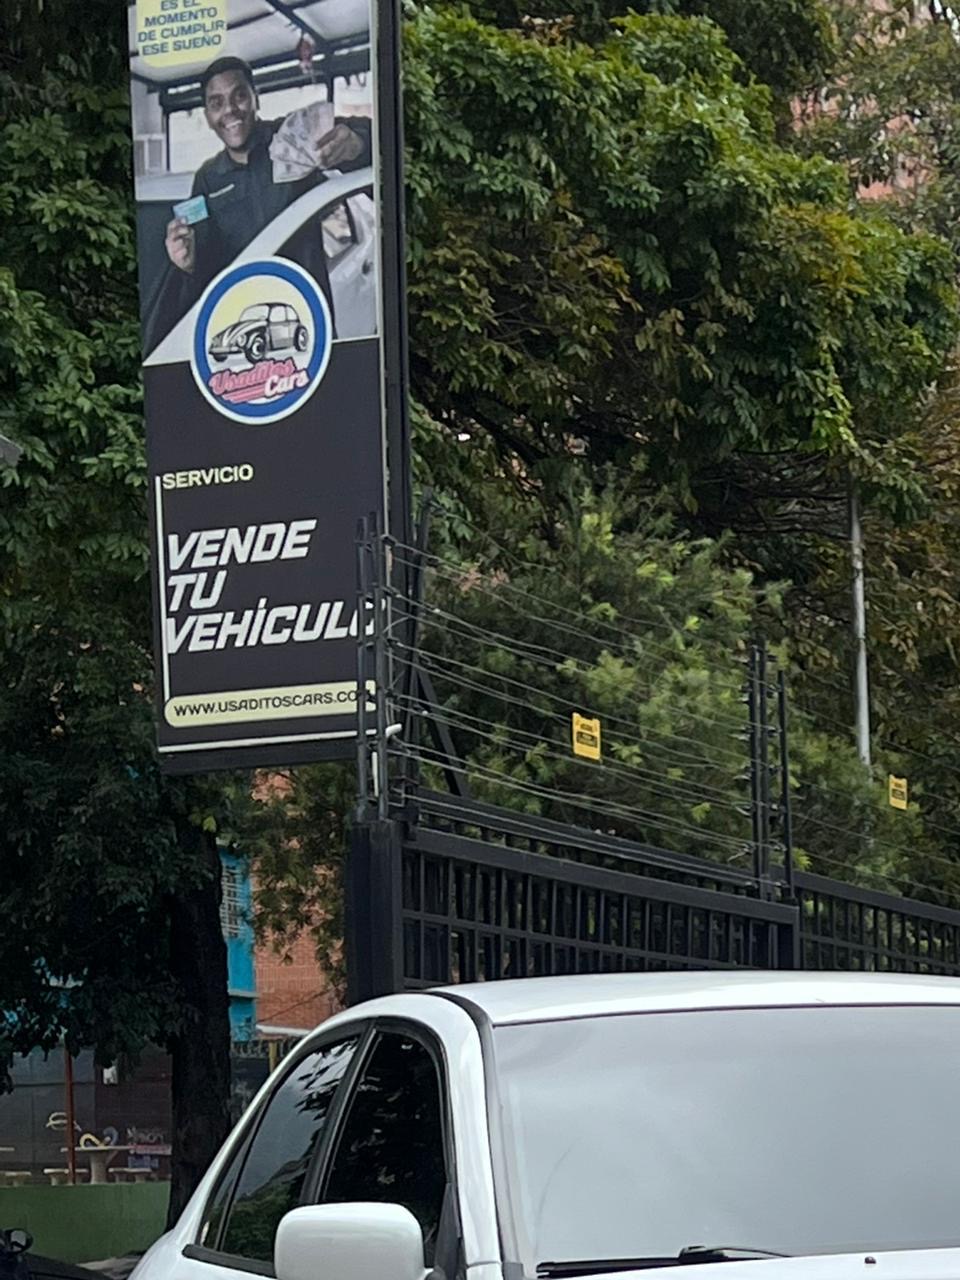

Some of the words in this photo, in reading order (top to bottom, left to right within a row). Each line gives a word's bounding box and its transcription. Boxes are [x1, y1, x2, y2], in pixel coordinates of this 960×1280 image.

[144, 7, 218, 27] MOMENTO
[160, 0, 178, 11] ES
[183, 0, 201, 8] EL
[138, 30, 157, 42] DE
[160, 20, 225, 39] CUMPLIR
[142, 41, 169, 56] ESE
[264, 370, 309, 397] Cars
[162, 463, 254, 490] SERVICIO
[167, 518, 318, 571] VENDE
[167, 569, 228, 612] TU
[173, 689, 366, 717] WWW.USADITOSCARS.CO
